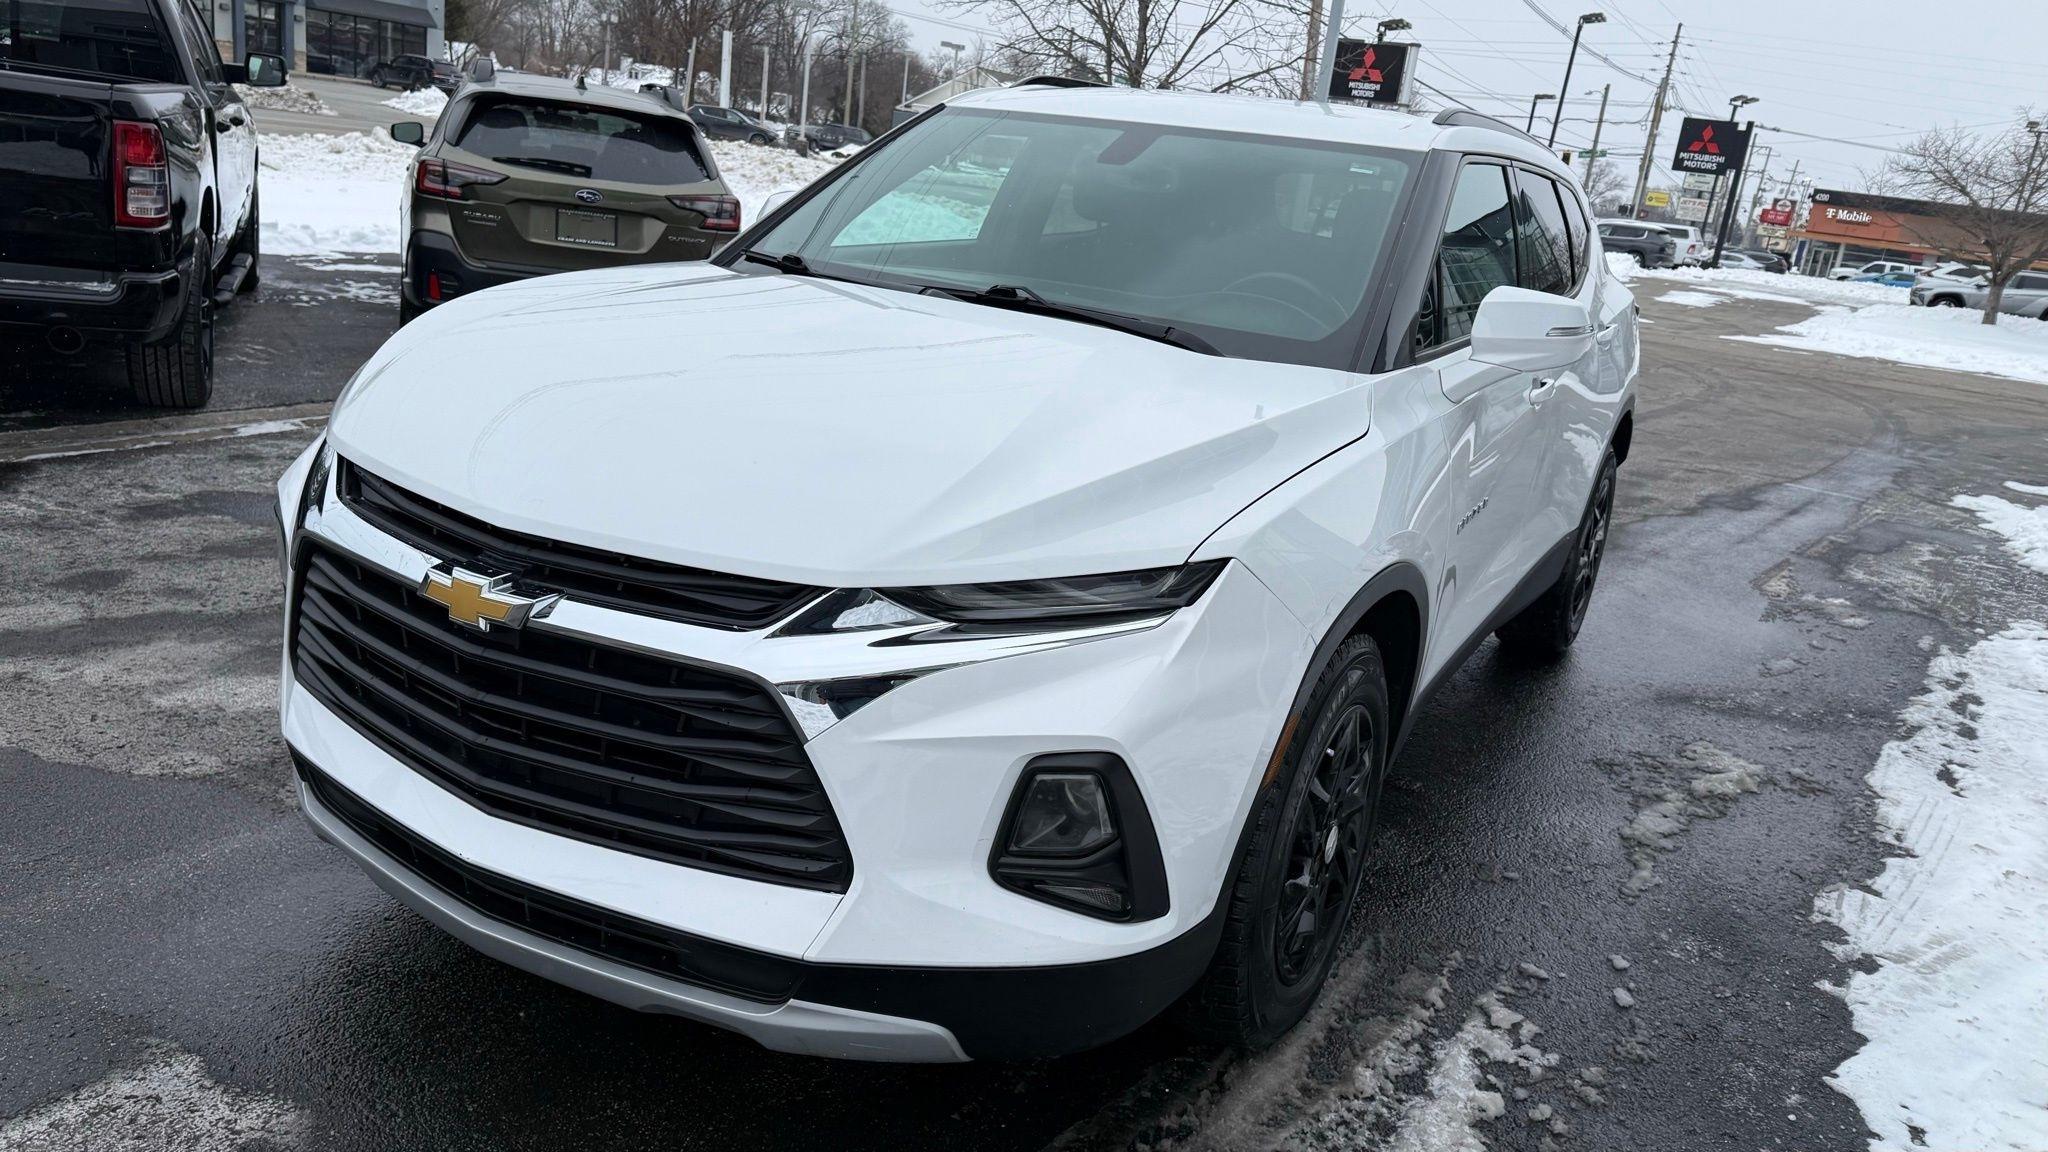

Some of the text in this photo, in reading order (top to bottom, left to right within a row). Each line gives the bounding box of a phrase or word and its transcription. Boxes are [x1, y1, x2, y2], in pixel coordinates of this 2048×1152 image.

[1348, 81, 1381, 91] MITSUBISHI
[1351, 89, 1375, 98] MOTORS
[1679, 152, 1726, 163] MITSUBISHI
[1683, 160, 1719, 170] MOTORS
